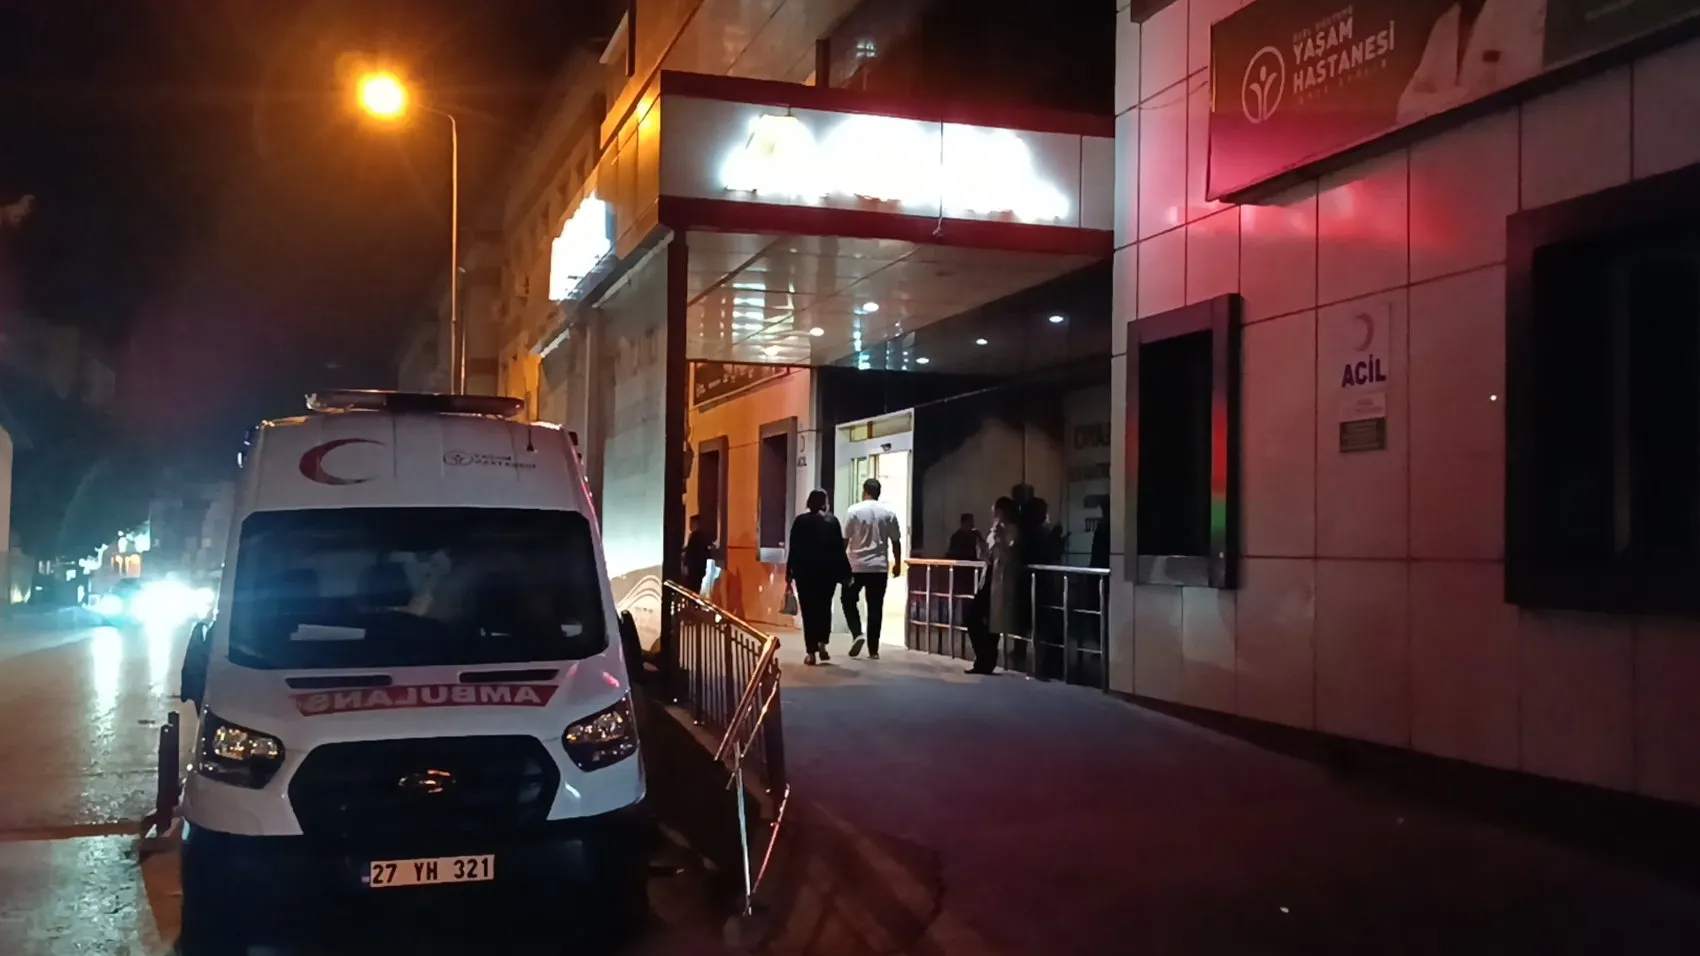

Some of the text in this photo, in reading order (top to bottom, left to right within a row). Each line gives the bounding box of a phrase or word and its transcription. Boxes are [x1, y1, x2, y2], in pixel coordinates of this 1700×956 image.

[1293, 17, 1353, 64] YAŞAM
[1293, 20, 1394, 94] HASTANESİ
[1342, 354, 1386, 388] ACİL
[372, 857, 489, 884] 27 YH 321
